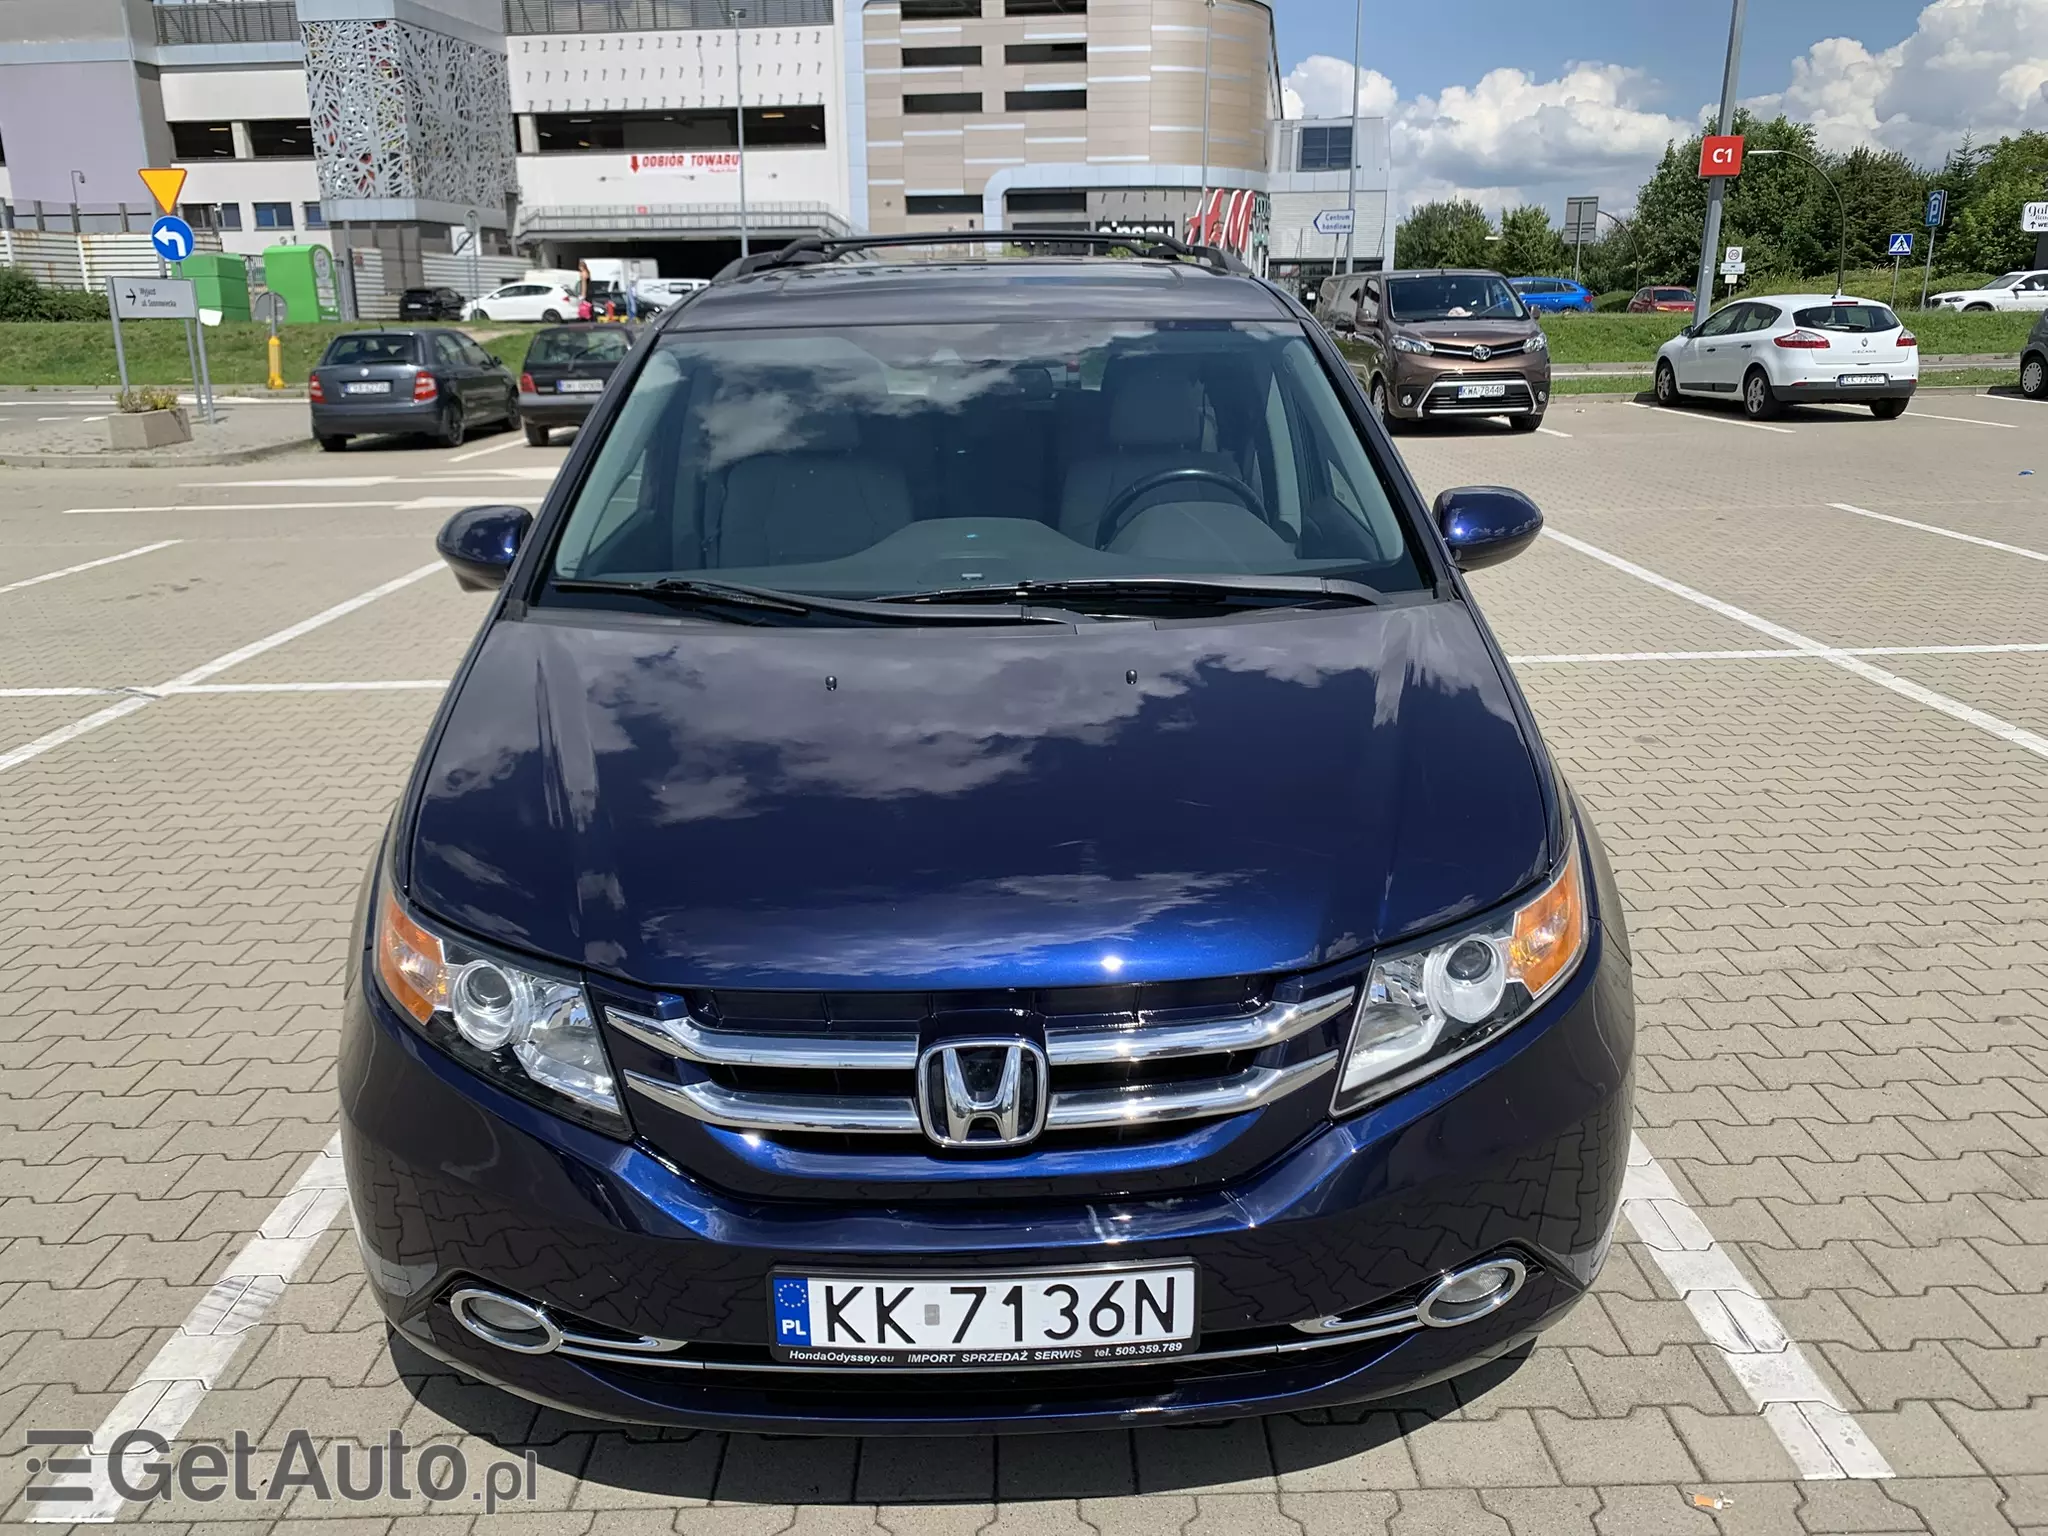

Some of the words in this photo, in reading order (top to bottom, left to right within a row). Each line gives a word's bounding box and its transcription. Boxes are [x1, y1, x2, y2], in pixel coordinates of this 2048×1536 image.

[691, 154, 740, 166] TOWARU
[1712, 147, 1733, 163] C1
[782, 1319, 806, 1335] PL
[825, 1285, 916, 1344] KK
[950, 1277, 1175, 1345] 7136N
[789, 1350, 894, 1364] HondaOdyssey.eu
[907, 1354, 956, 1363] IMPORT
[961, 1350, 1028, 1363] SPRZEDAŻ
[1034, 1349, 1082, 1361] SERWIS
[1094, 1348, 1111, 1358] tel.
[1115, 1342, 1182, 1356] 509.359.789
